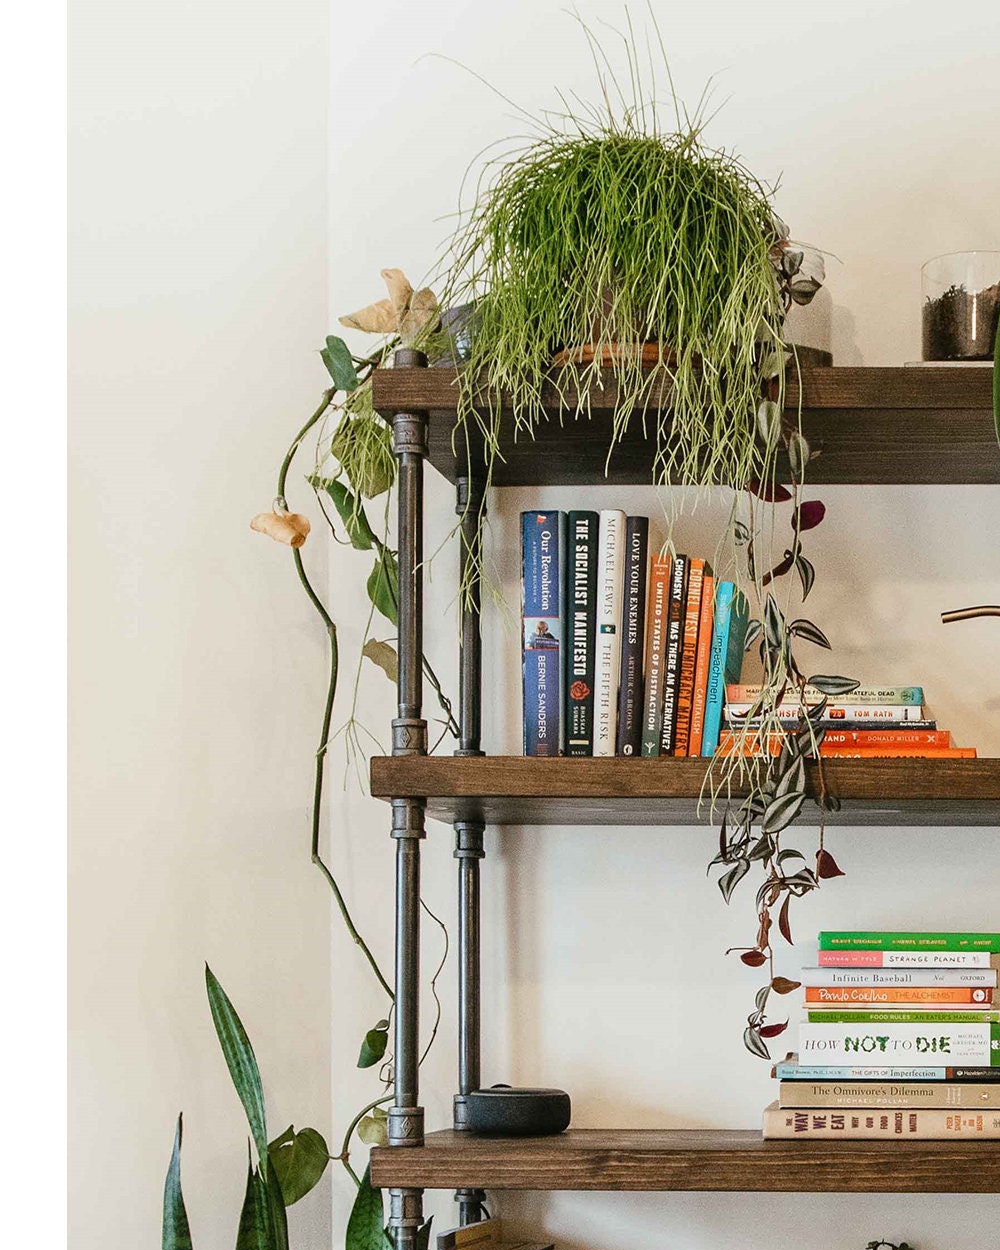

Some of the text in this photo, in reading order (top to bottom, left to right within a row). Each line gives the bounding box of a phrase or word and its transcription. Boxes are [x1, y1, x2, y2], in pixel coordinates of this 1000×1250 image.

[540, 530, 552, 610] Our Revolution
[604, 518, 616, 615] MICHAEL LEWIS
[628, 532, 640, 644] LOVE YOUR ENEMIES
[672, 559, 684, 600] CHOMSKY
[573, 520, 588, 676] THE SOCIALIST MANIFESTO
[656, 582, 664, 616] UNITED
[653, 619, 662, 650] STATES
[670, 621, 680, 640] WAS
[652, 654, 660, 666] OF
[668, 642, 678, 670] THERE
[676, 568, 704, 750] CORNEL WEST DEMOCRACY MATTERS
[666, 672, 676, 685] AN
[710, 635, 725, 704] impeachment
[538, 656, 547, 739] BERNIE SANDERS
[600, 644, 611, 740] THE FIFTH RISK
[648, 670, 658, 730] DISTRACTION
[662, 687, 674, 750] ALTERNATIVE?
[694, 688, 704, 734] CAPITALISM
[832, 974, 912, 982] Infinite Baseball
[818, 988, 888, 1000] Paulo Coelho
[804, 1040, 840, 1050] HOW
[844, 1036, 890, 1053] NOT
[890, 1040, 912, 1050] TO
[916, 1036, 950, 1054] DIE
[890, 1068, 936, 1078] Imperfection
[812, 1086, 934, 1096] The Omnivore's Dilemma
[794, 1112, 808, 1132] WAY
[813, 1116, 826, 1130] WE
[831, 1114, 844, 1130] EAT
[851, 1116, 860, 1128] WHY
[880, 1116, 888, 1130] FOOD
[894, 1112, 902, 1134] CHOICES
[909, 1114, 917, 1132] MATTER
